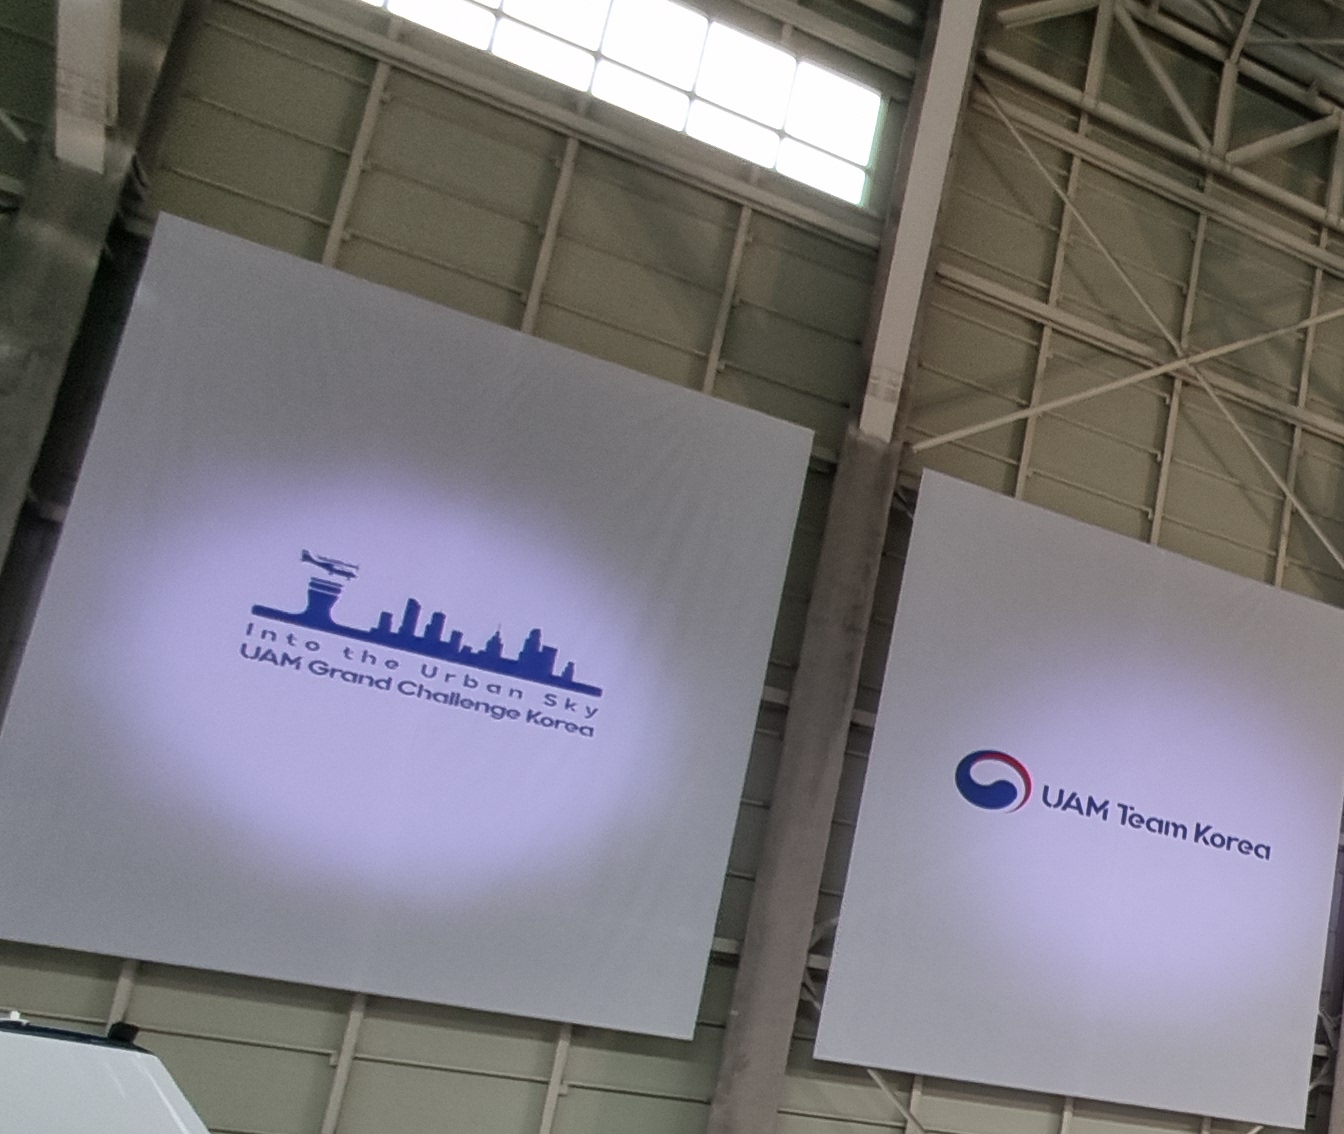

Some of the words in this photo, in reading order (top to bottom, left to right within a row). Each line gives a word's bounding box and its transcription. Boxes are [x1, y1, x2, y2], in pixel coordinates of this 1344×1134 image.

[240, 642, 302, 670] UAM
[308, 660, 392, 692] Grand
[397, 680, 521, 721] Challenge
[526, 708, 595, 738] Korea
[245, 621, 320, 653] Into
[343, 646, 400, 669] the
[421, 663, 524, 699] Urban
[545, 693, 599, 719] Sky
[1042, 785, 1109, 821] UAM
[1118, 802, 1188, 840] Team
[1194, 822, 1272, 861] Korea
